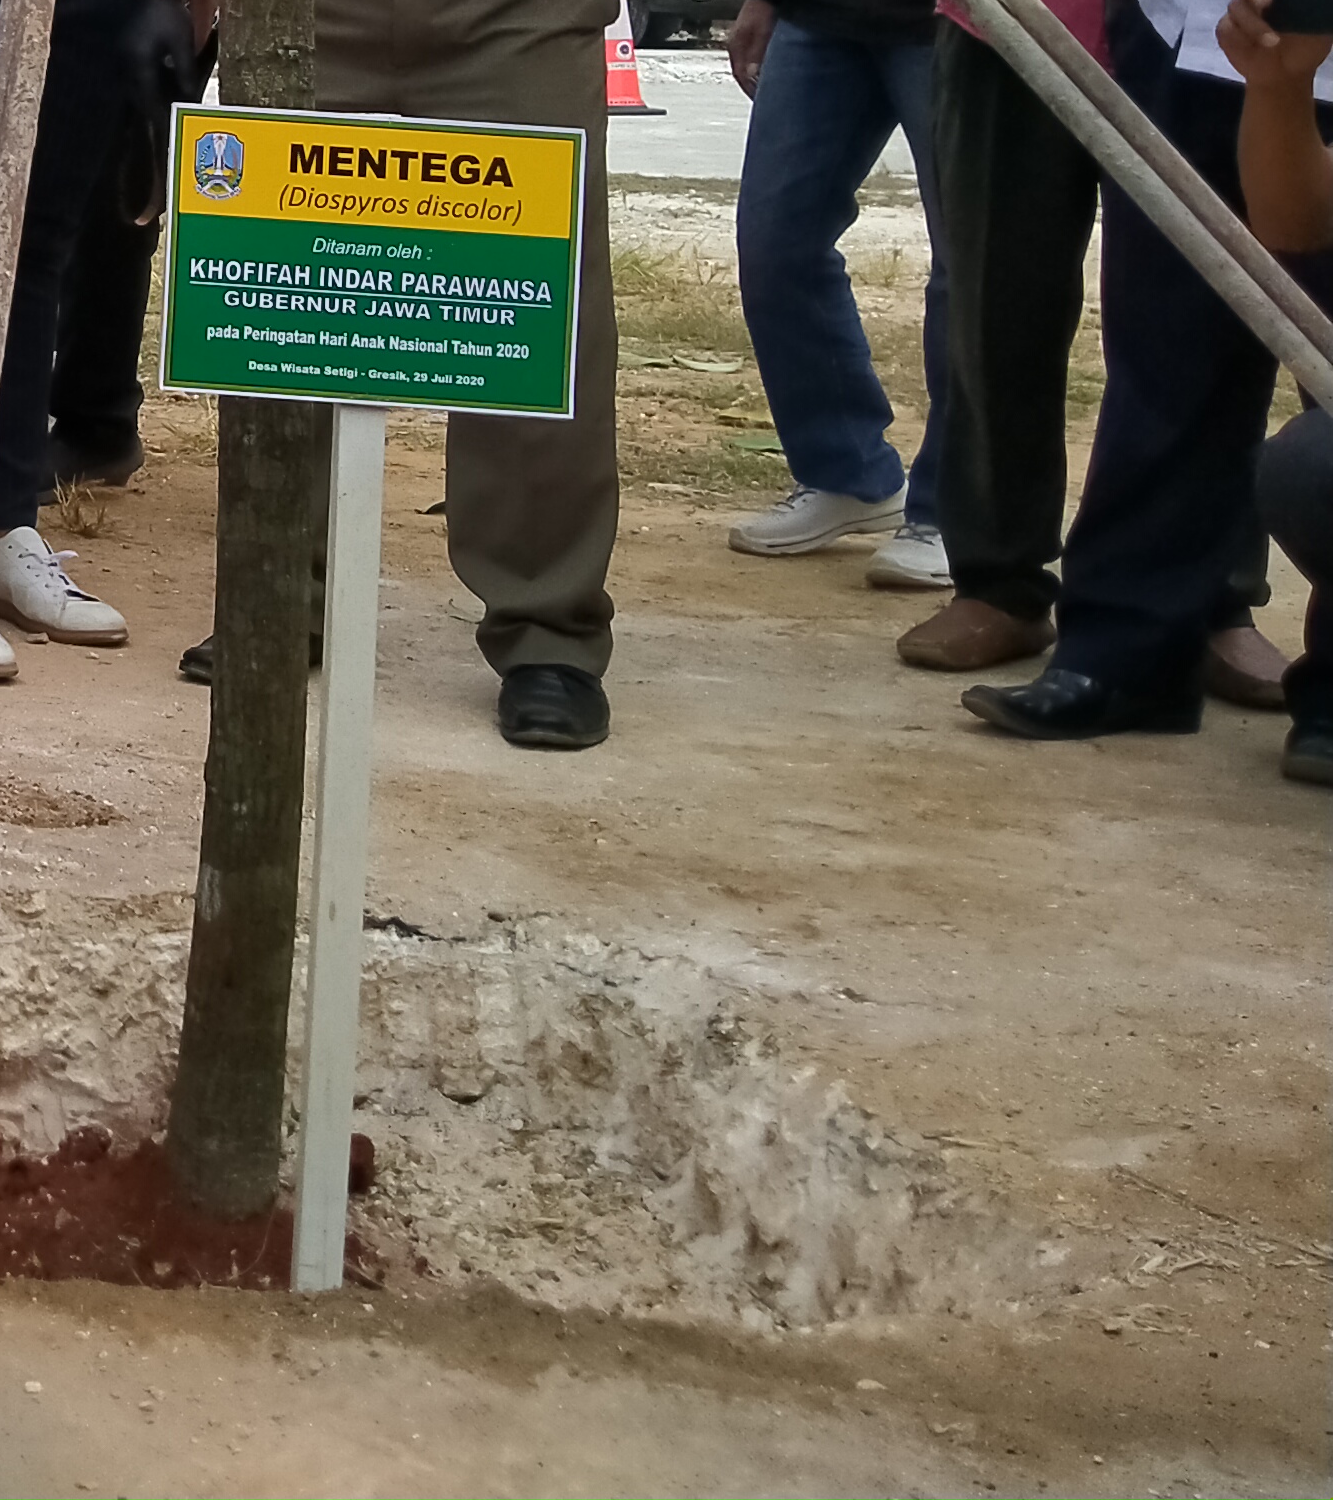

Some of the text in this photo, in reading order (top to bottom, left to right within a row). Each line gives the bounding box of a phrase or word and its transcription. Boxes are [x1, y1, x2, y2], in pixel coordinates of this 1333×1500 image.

[289, 143, 514, 188] MENTEGA
[279, 184, 409, 217] (Diospyros
[416, 194, 522, 226] discolor)
[312, 237, 382, 257] Ditanam
[386, 243, 422, 260] oleh
[190, 258, 552, 303] KHOFIFAH INDAR PARAWANSA
[224, 290, 515, 326] GUBERNUR JAWA TIMUR
[206, 325, 530, 359] pada Peringatan Hari Anak Nasional Tahun 2020
[248, 360, 278, 372] Desa
[281, 363, 321, 375] Wisata
[324, 366, 358, 379] Setigi
[368, 369, 410, 382] Gresik,
[413, 372, 428, 382] 29
[431, 374, 453, 384] Juli
[455, 375, 485, 386] 2020
